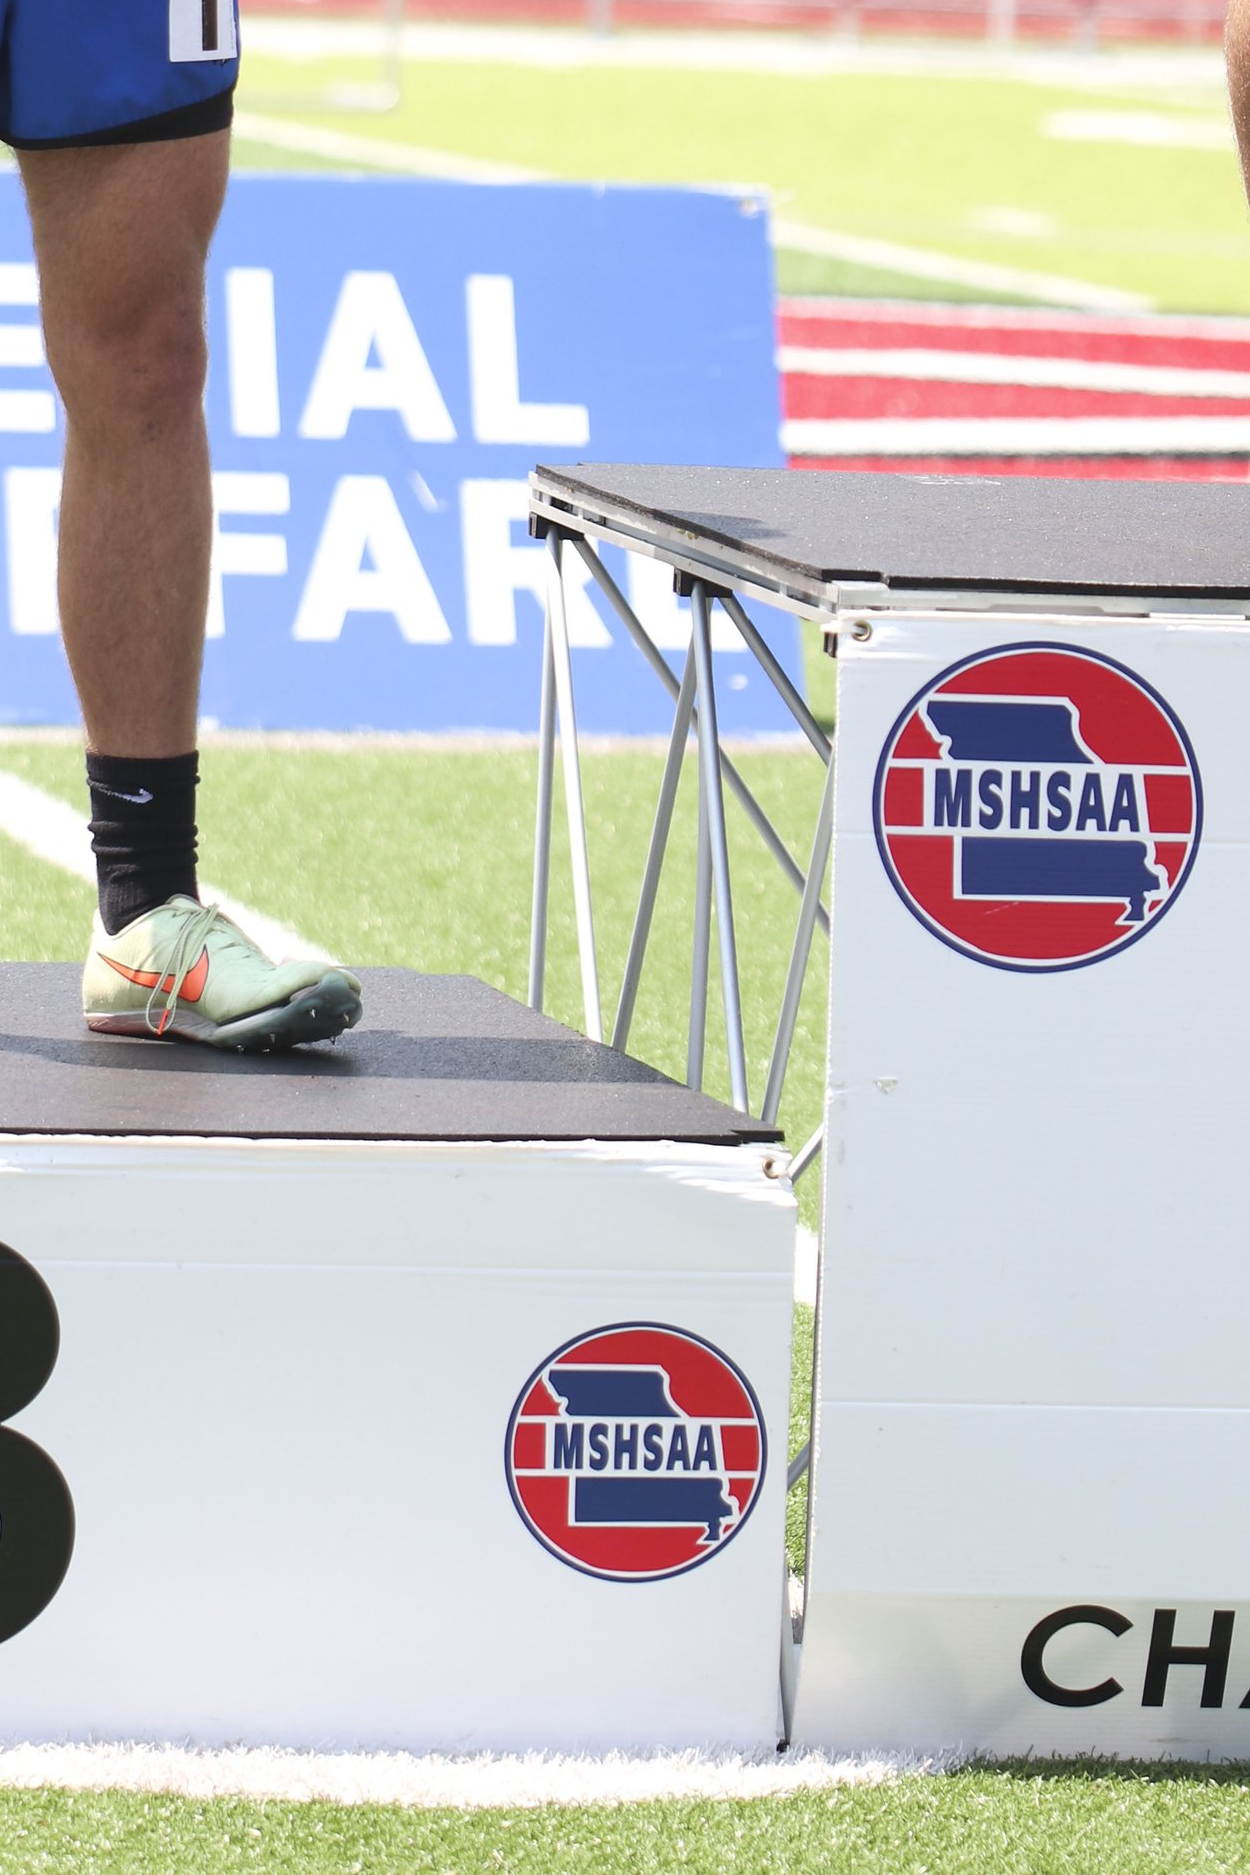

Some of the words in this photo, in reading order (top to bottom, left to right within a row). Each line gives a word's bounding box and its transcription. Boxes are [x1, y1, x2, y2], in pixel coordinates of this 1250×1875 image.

[934, 768, 1141, 832] MSHSAA
[553, 1422, 719, 1472] MSHSAA
[1021, 1605, 1250, 1708] CH
